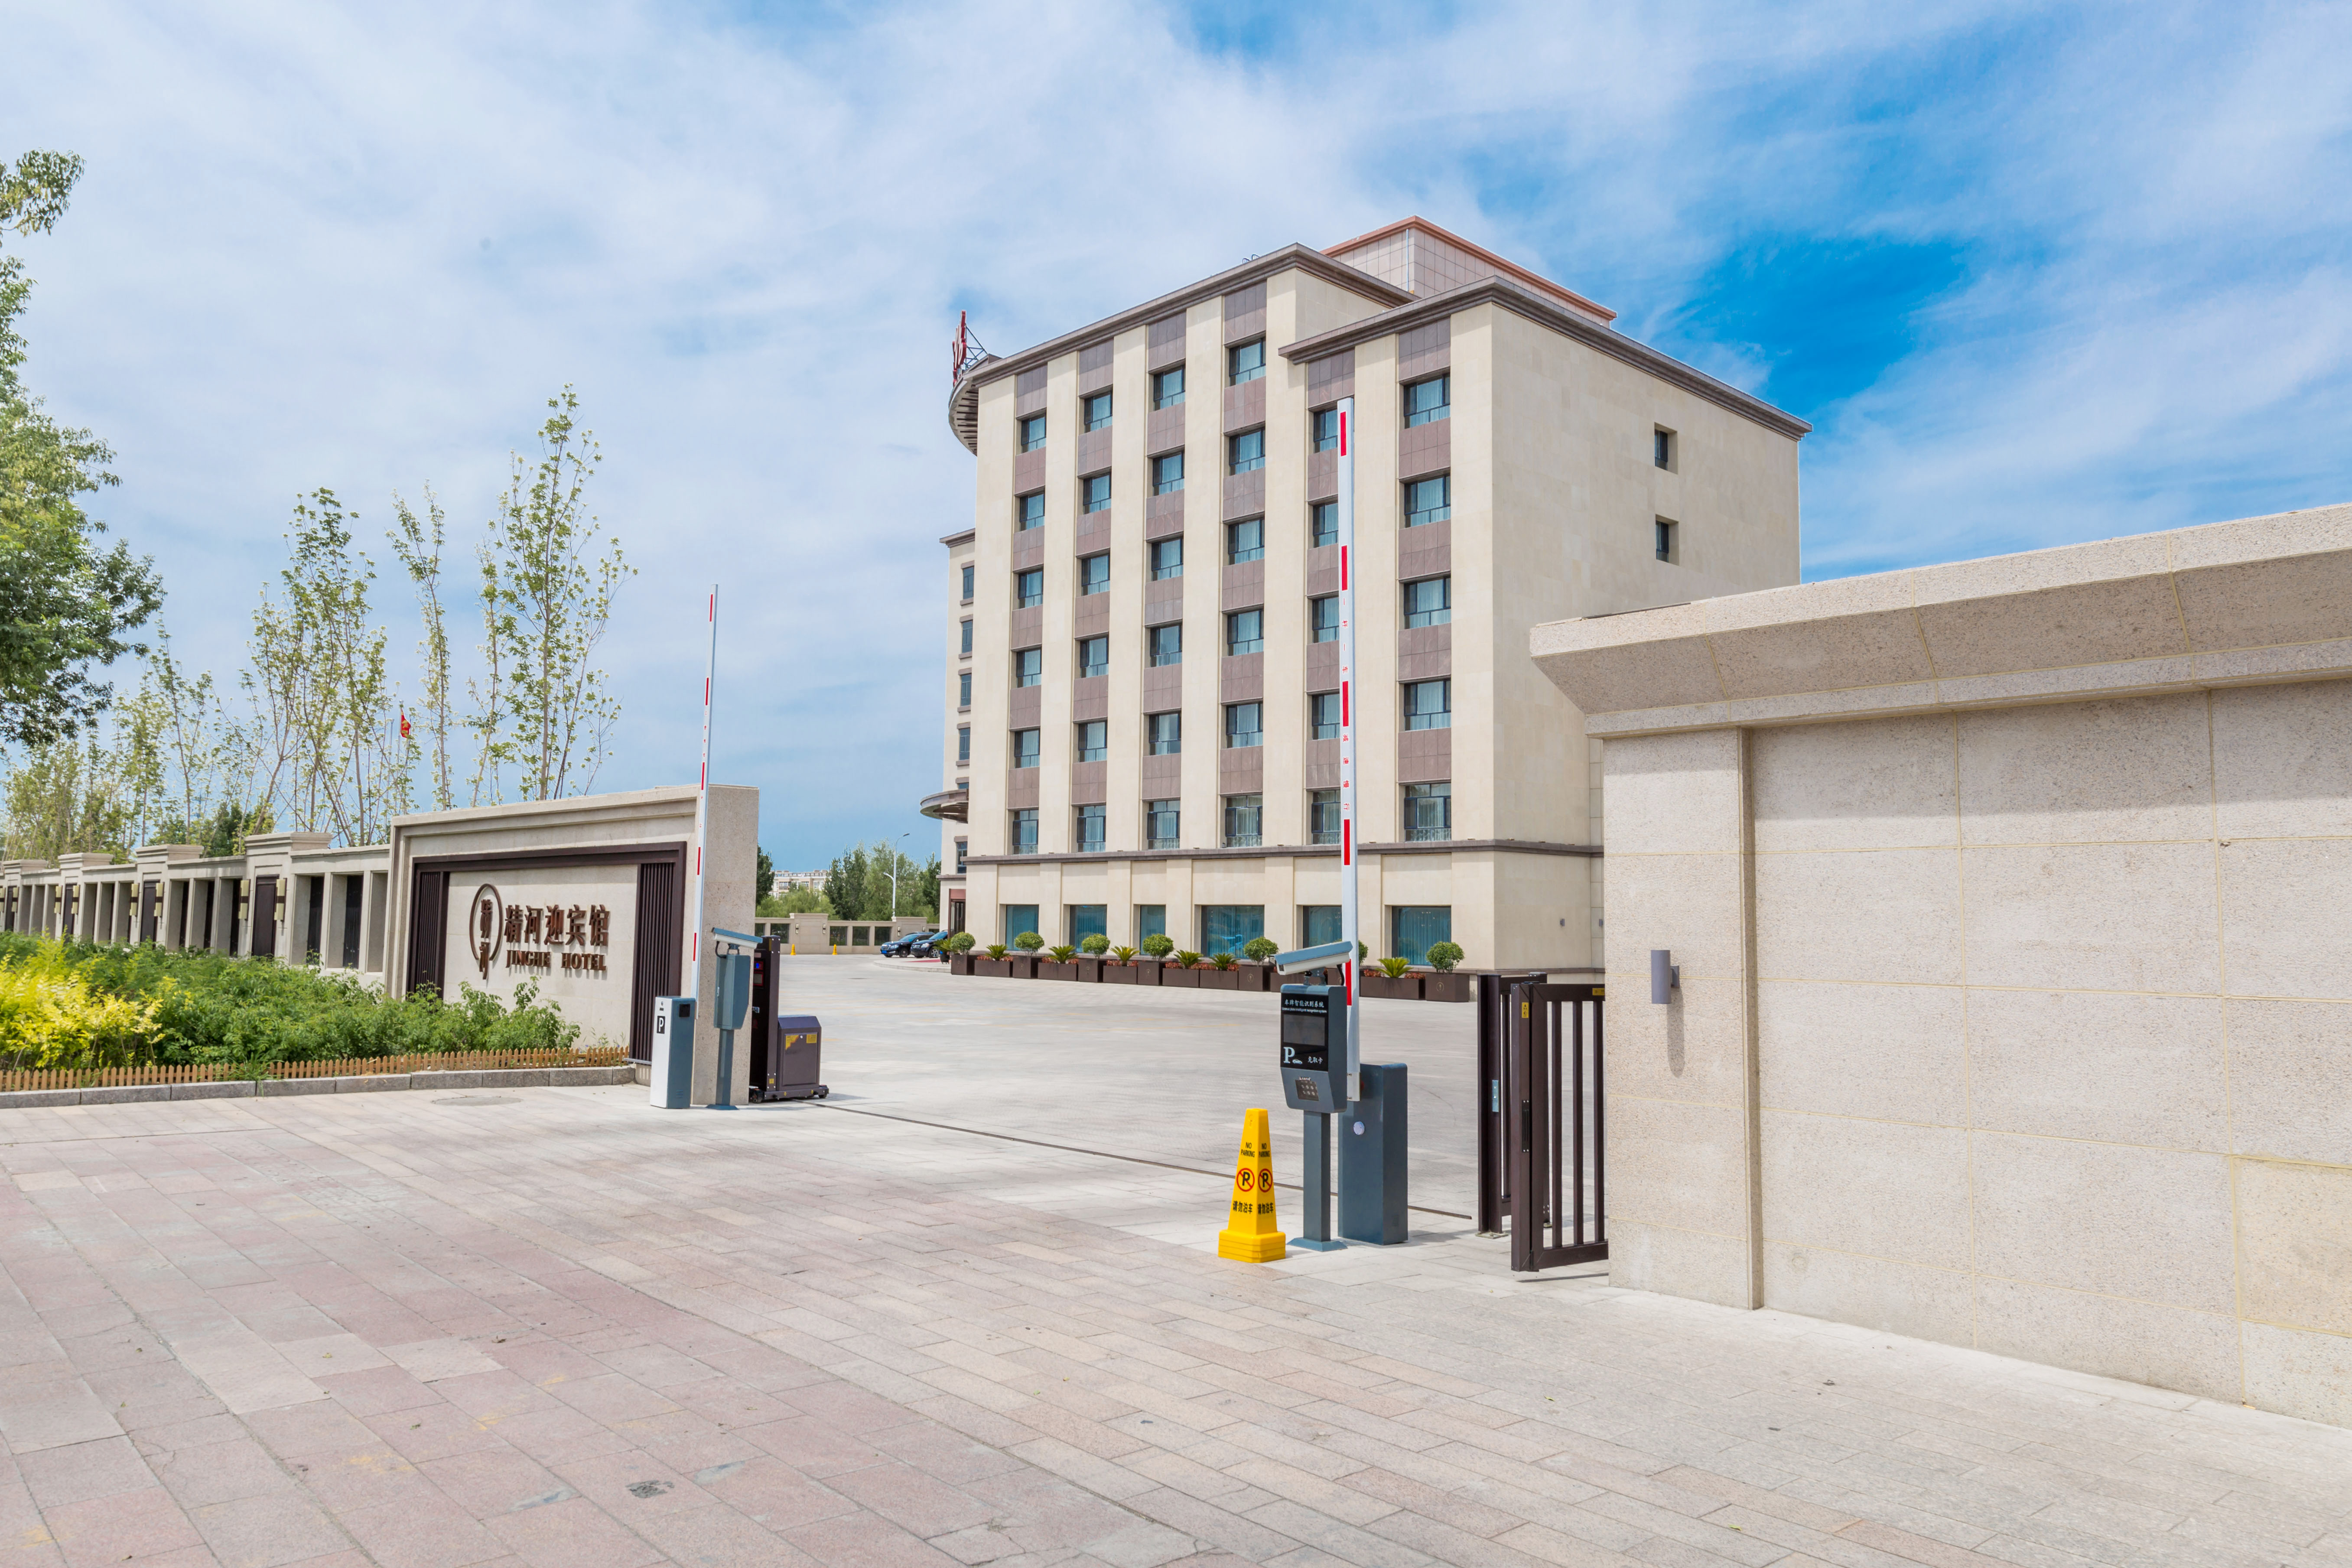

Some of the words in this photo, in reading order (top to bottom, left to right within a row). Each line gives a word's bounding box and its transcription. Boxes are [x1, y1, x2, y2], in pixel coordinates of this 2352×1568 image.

[506, 950, 551, 968] JINGHE
[561, 953, 607, 971] HOTEL
[659, 1018, 664, 1032] P
[1283, 1047, 1295, 1064] P
[1240, 1149, 1255, 1158] PARKING
[1233, 1200, 1253, 1214] 请勿泊车
[1258, 1202, 1273, 1214] 请勿泊车
